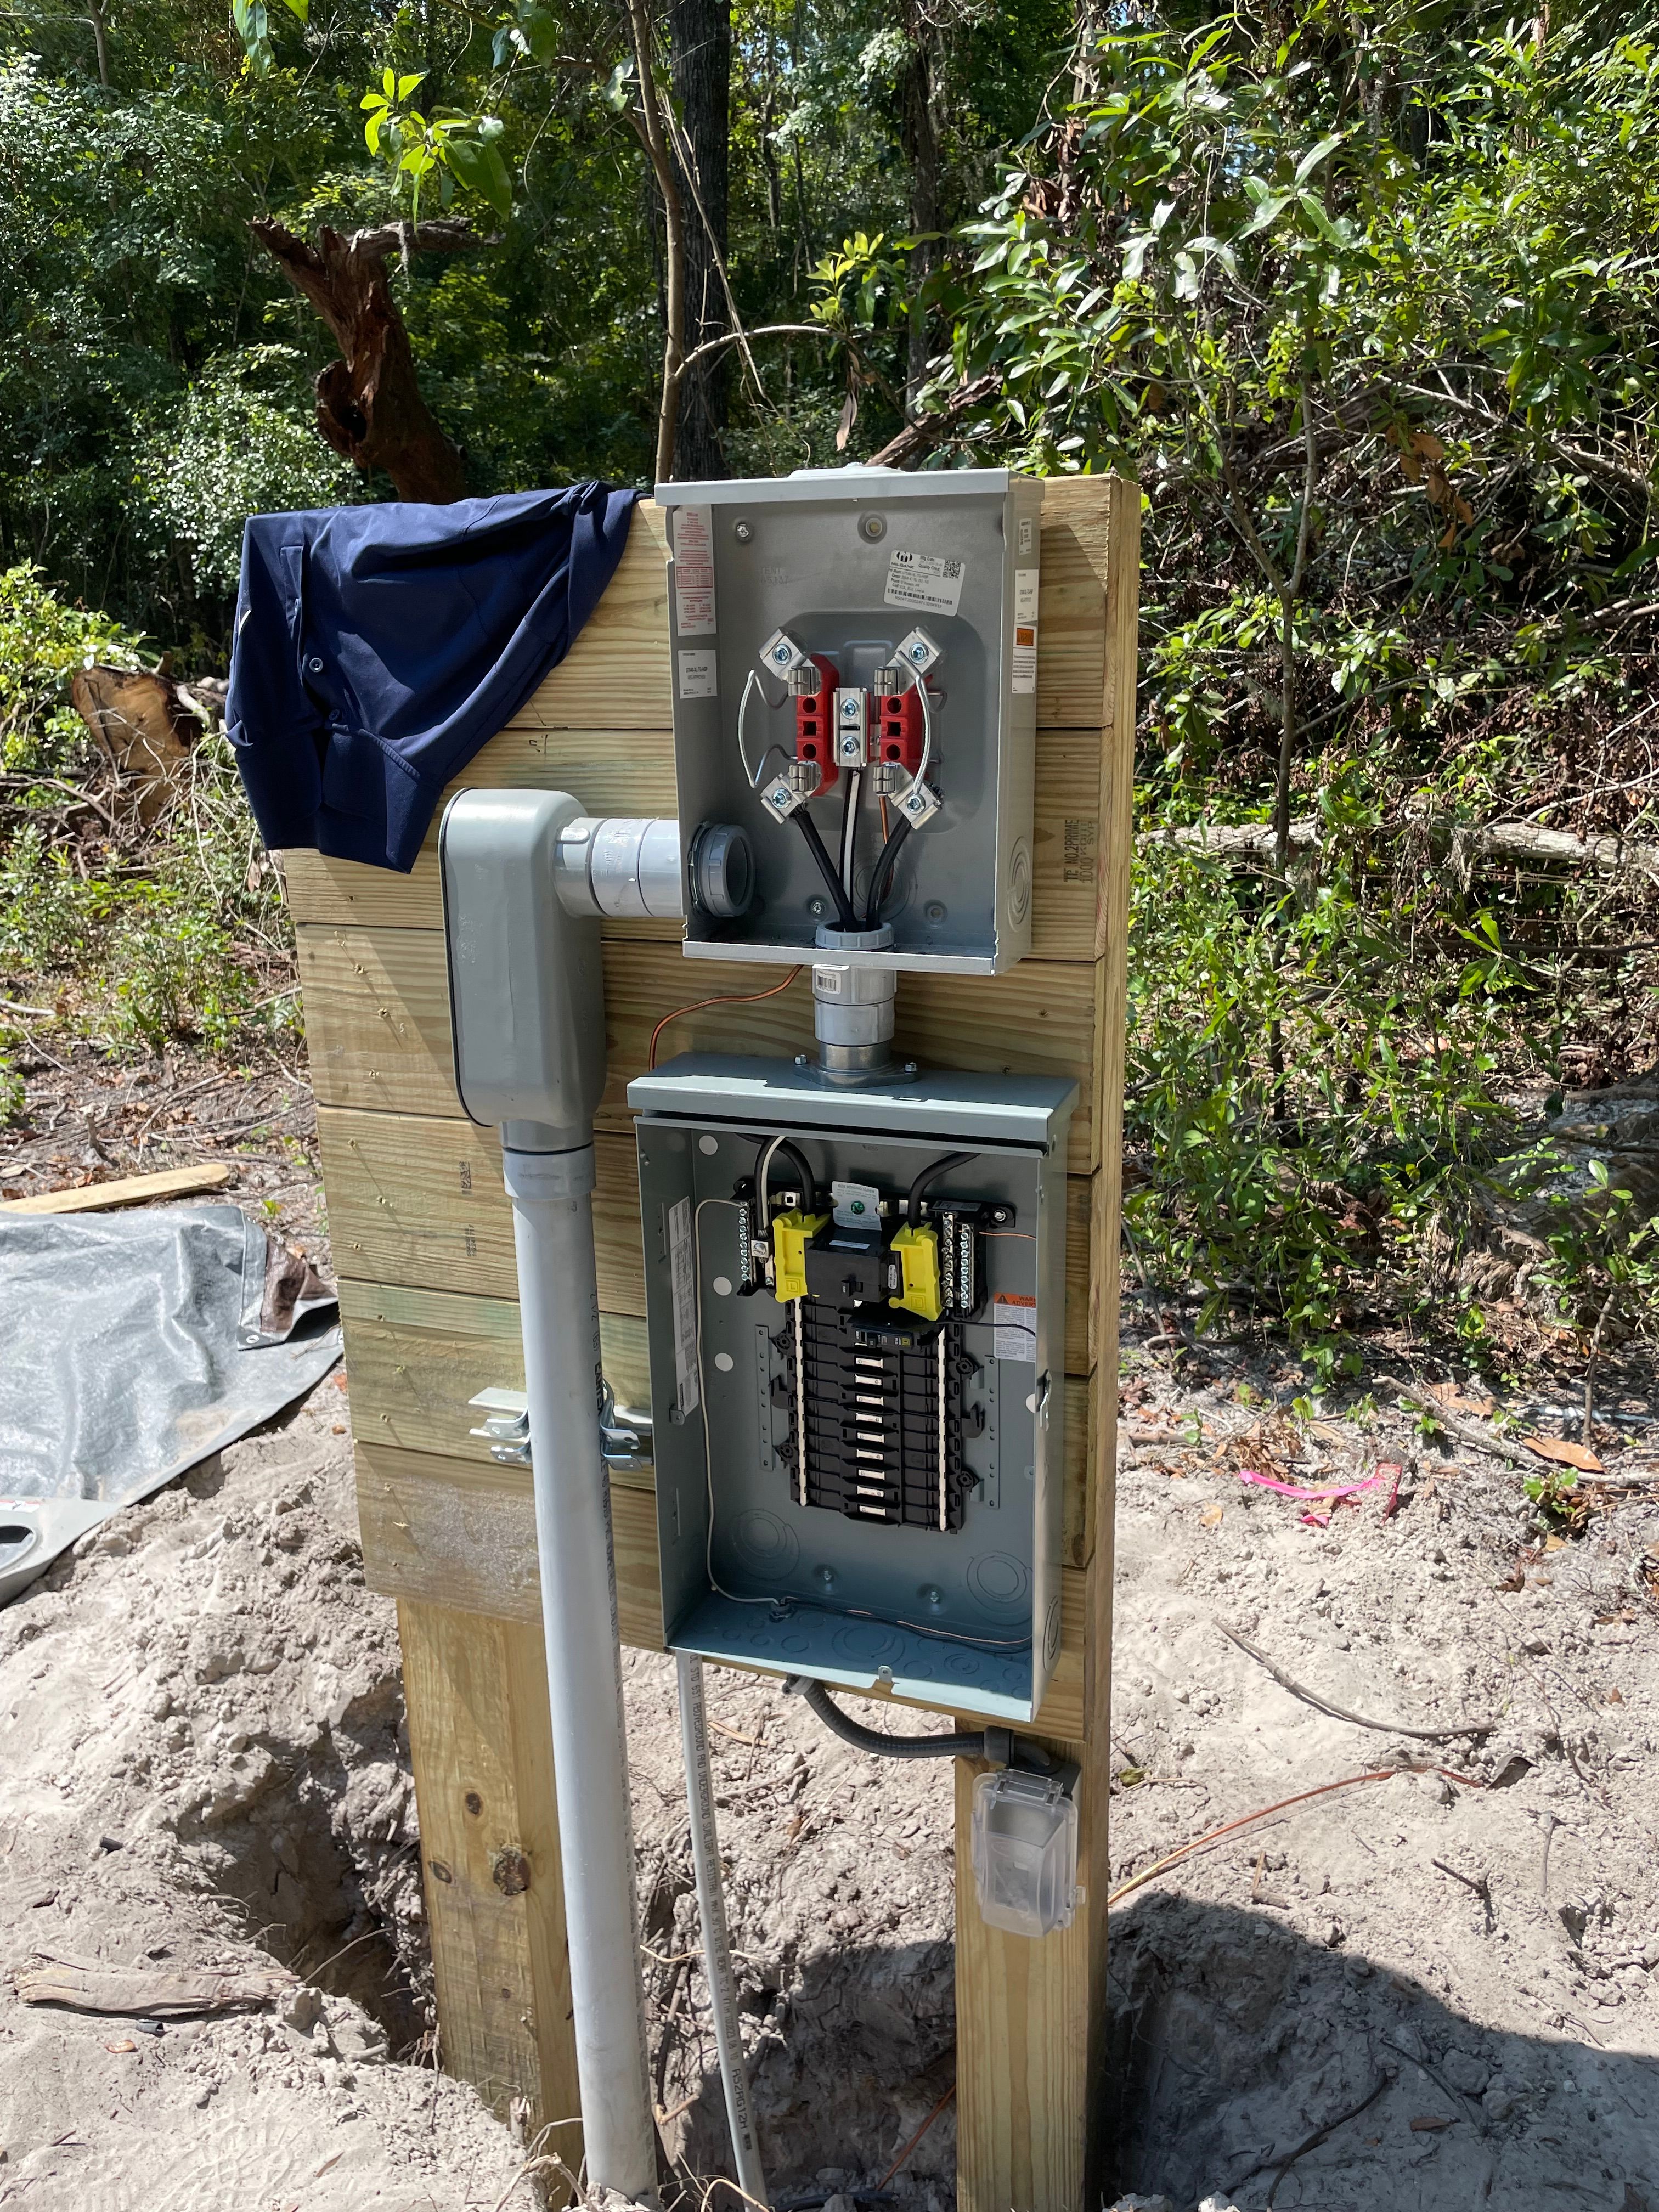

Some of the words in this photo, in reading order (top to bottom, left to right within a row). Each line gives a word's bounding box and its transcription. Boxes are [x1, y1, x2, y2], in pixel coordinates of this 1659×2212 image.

[690, 1667, 700, 1681] STD
[691, 1684, 701, 1698] 651
[692, 1702, 705, 1751] ABOVEGROUND
[696, 1753, 707, 1768] AND
[697, 1771, 711, 1819] UNDERGROUND
[702, 1822, 715, 1855] SUNLIGHT
[706, 1859, 719, 1897] RESISTANT
[732, 2068, 748, 2129] A52AG12H
